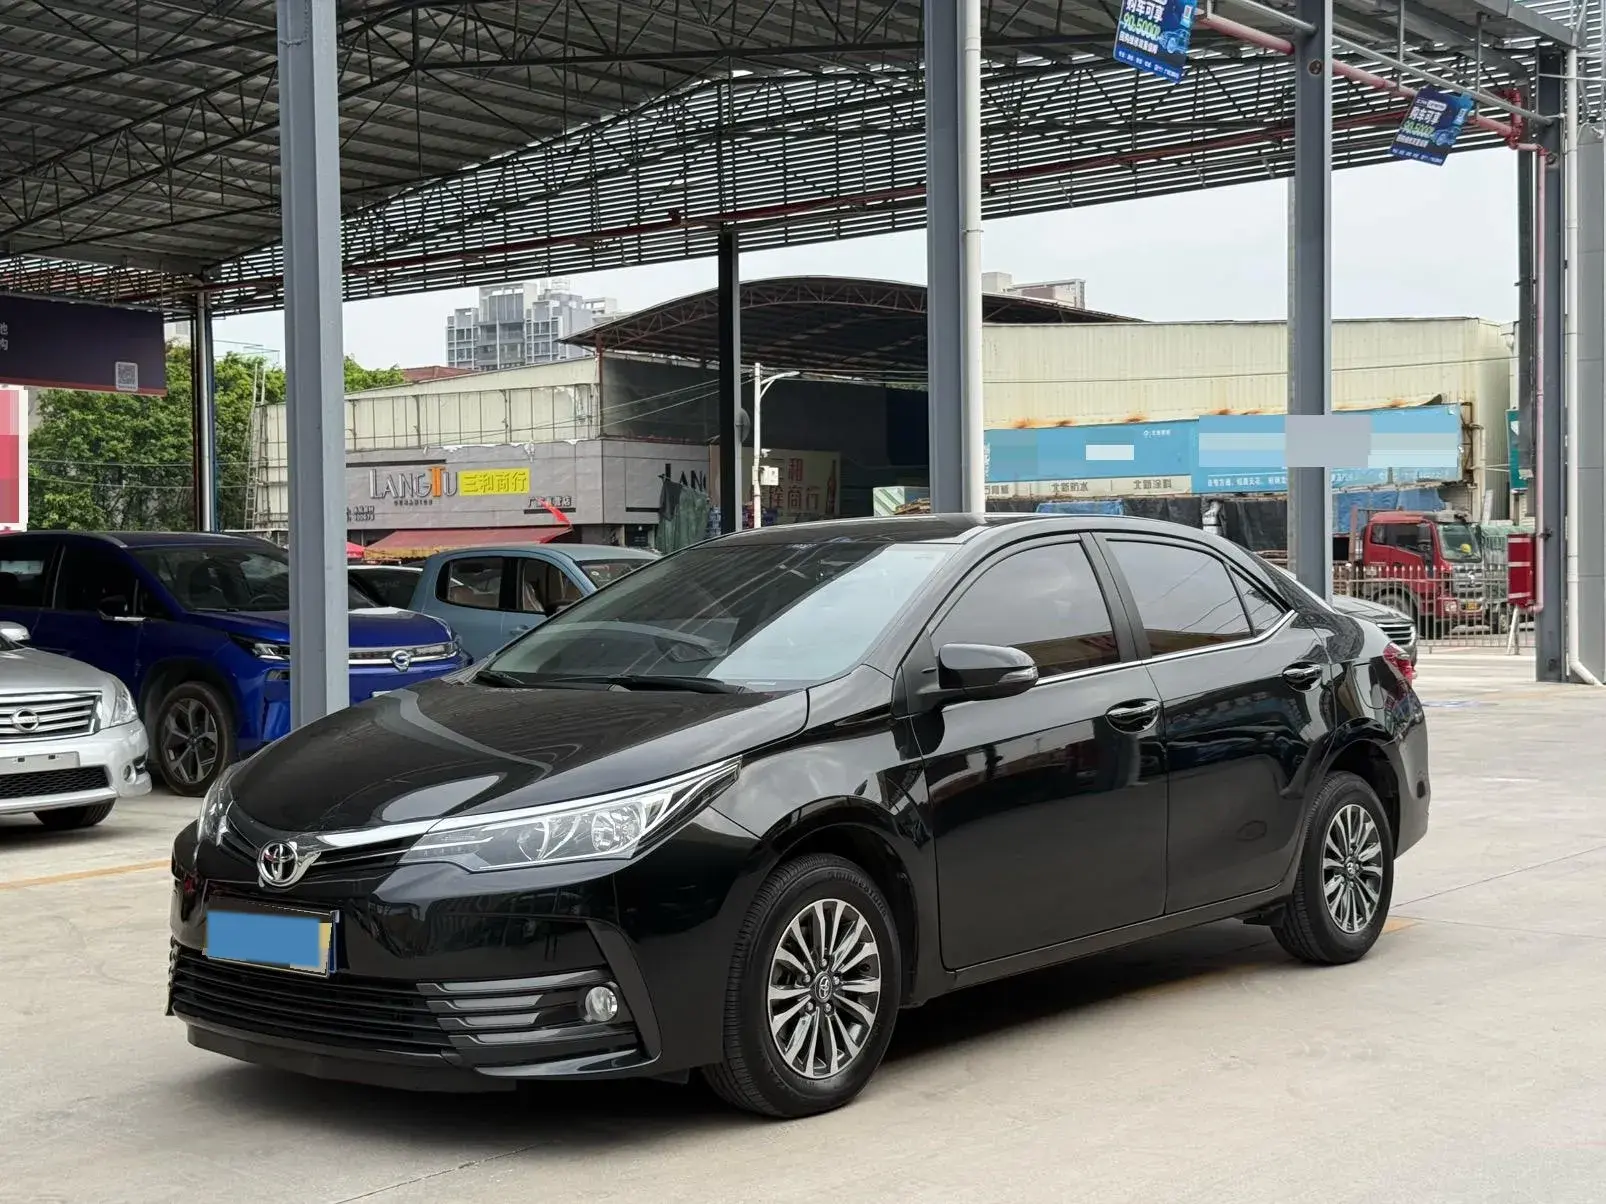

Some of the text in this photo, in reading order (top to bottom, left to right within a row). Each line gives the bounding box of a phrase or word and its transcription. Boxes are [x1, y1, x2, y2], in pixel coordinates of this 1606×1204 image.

[369, 466, 458, 499] LANGTU
[463, 471, 528, 494] 三和商行
[665, 463, 706, 492] AN
